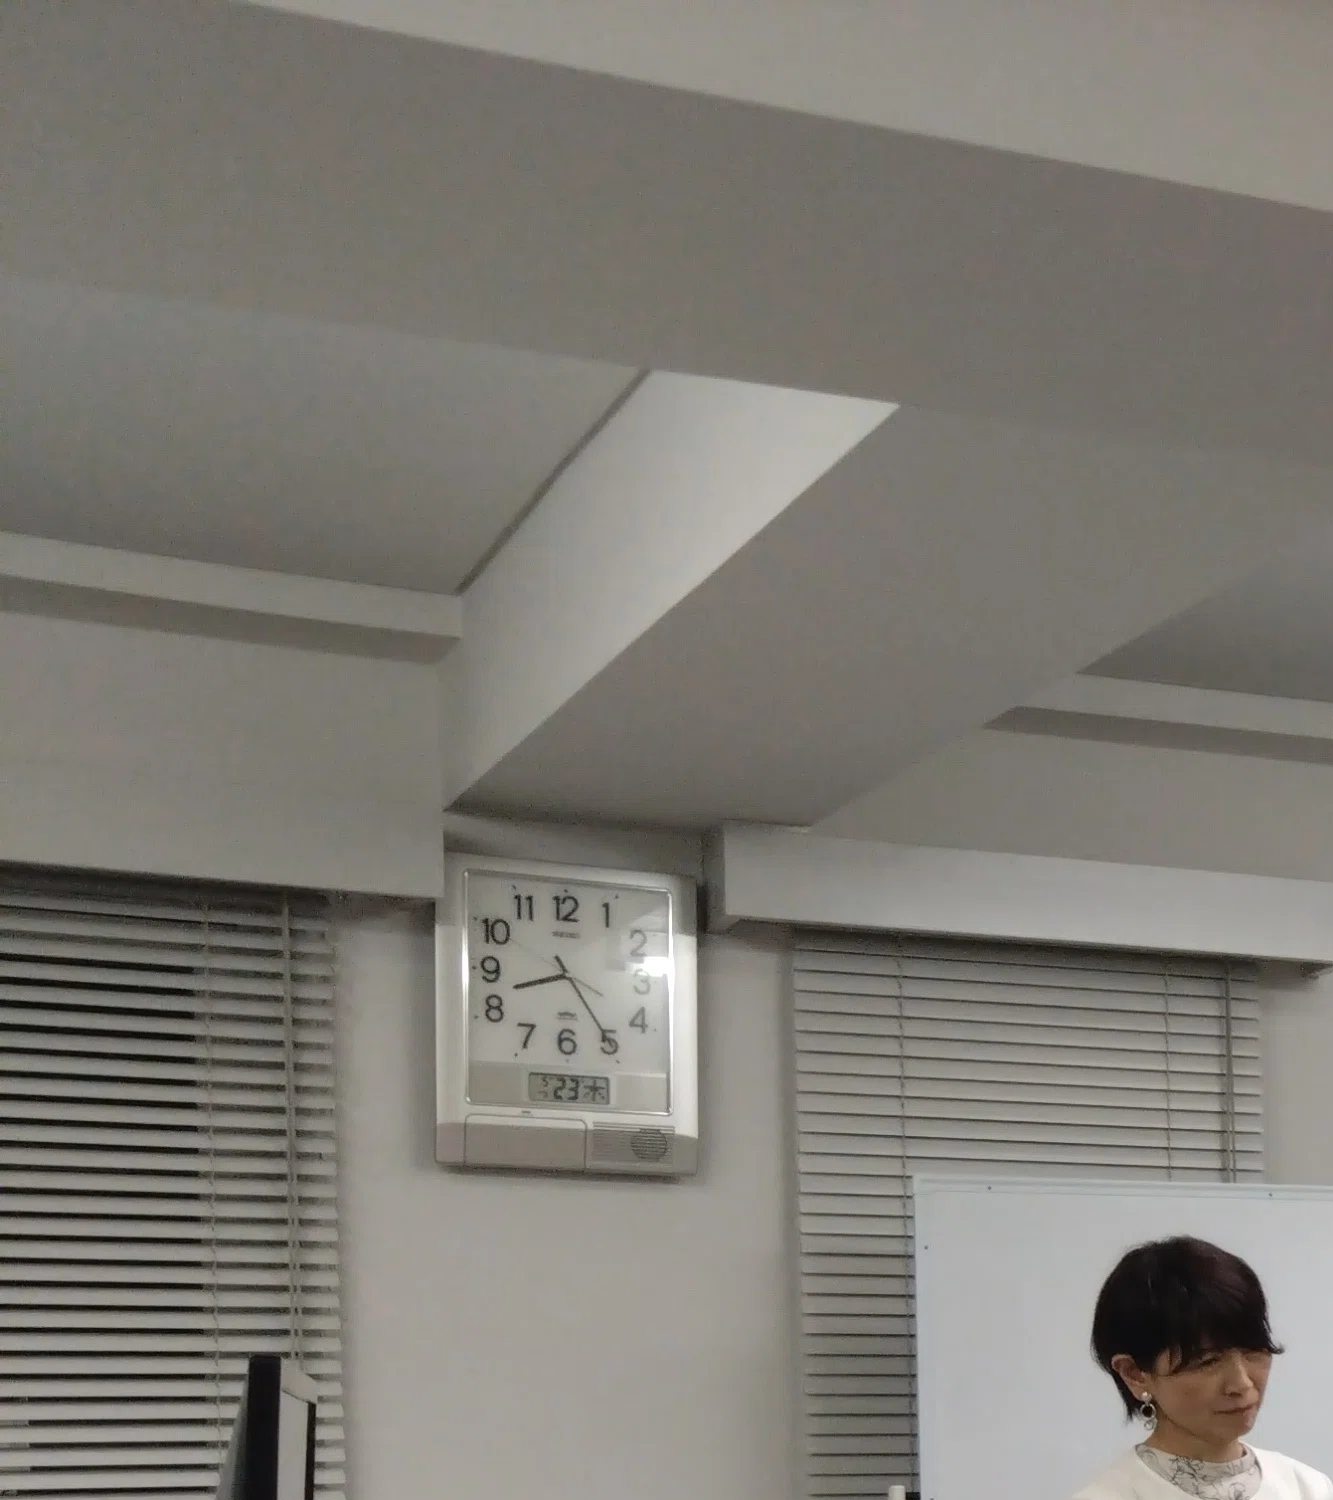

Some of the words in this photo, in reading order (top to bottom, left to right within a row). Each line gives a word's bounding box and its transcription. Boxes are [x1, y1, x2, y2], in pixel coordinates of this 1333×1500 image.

[514, 894, 534, 922] 11
[552, 895, 580, 923] 12
[602, 902, 611, 928] 1
[482, 917, 511, 945] 10
[629, 929, 648, 957] 2
[480, 956, 501, 983] 9
[633, 968, 651, 995] 3
[485, 994, 504, 1023] 8
[629, 1006, 648, 1034] 4
[517, 1022, 537, 1049] 7
[557, 1028, 577, 1056] 6
[600, 1029, 619, 1056] 5
[553, 1076, 579, 1101] 23
